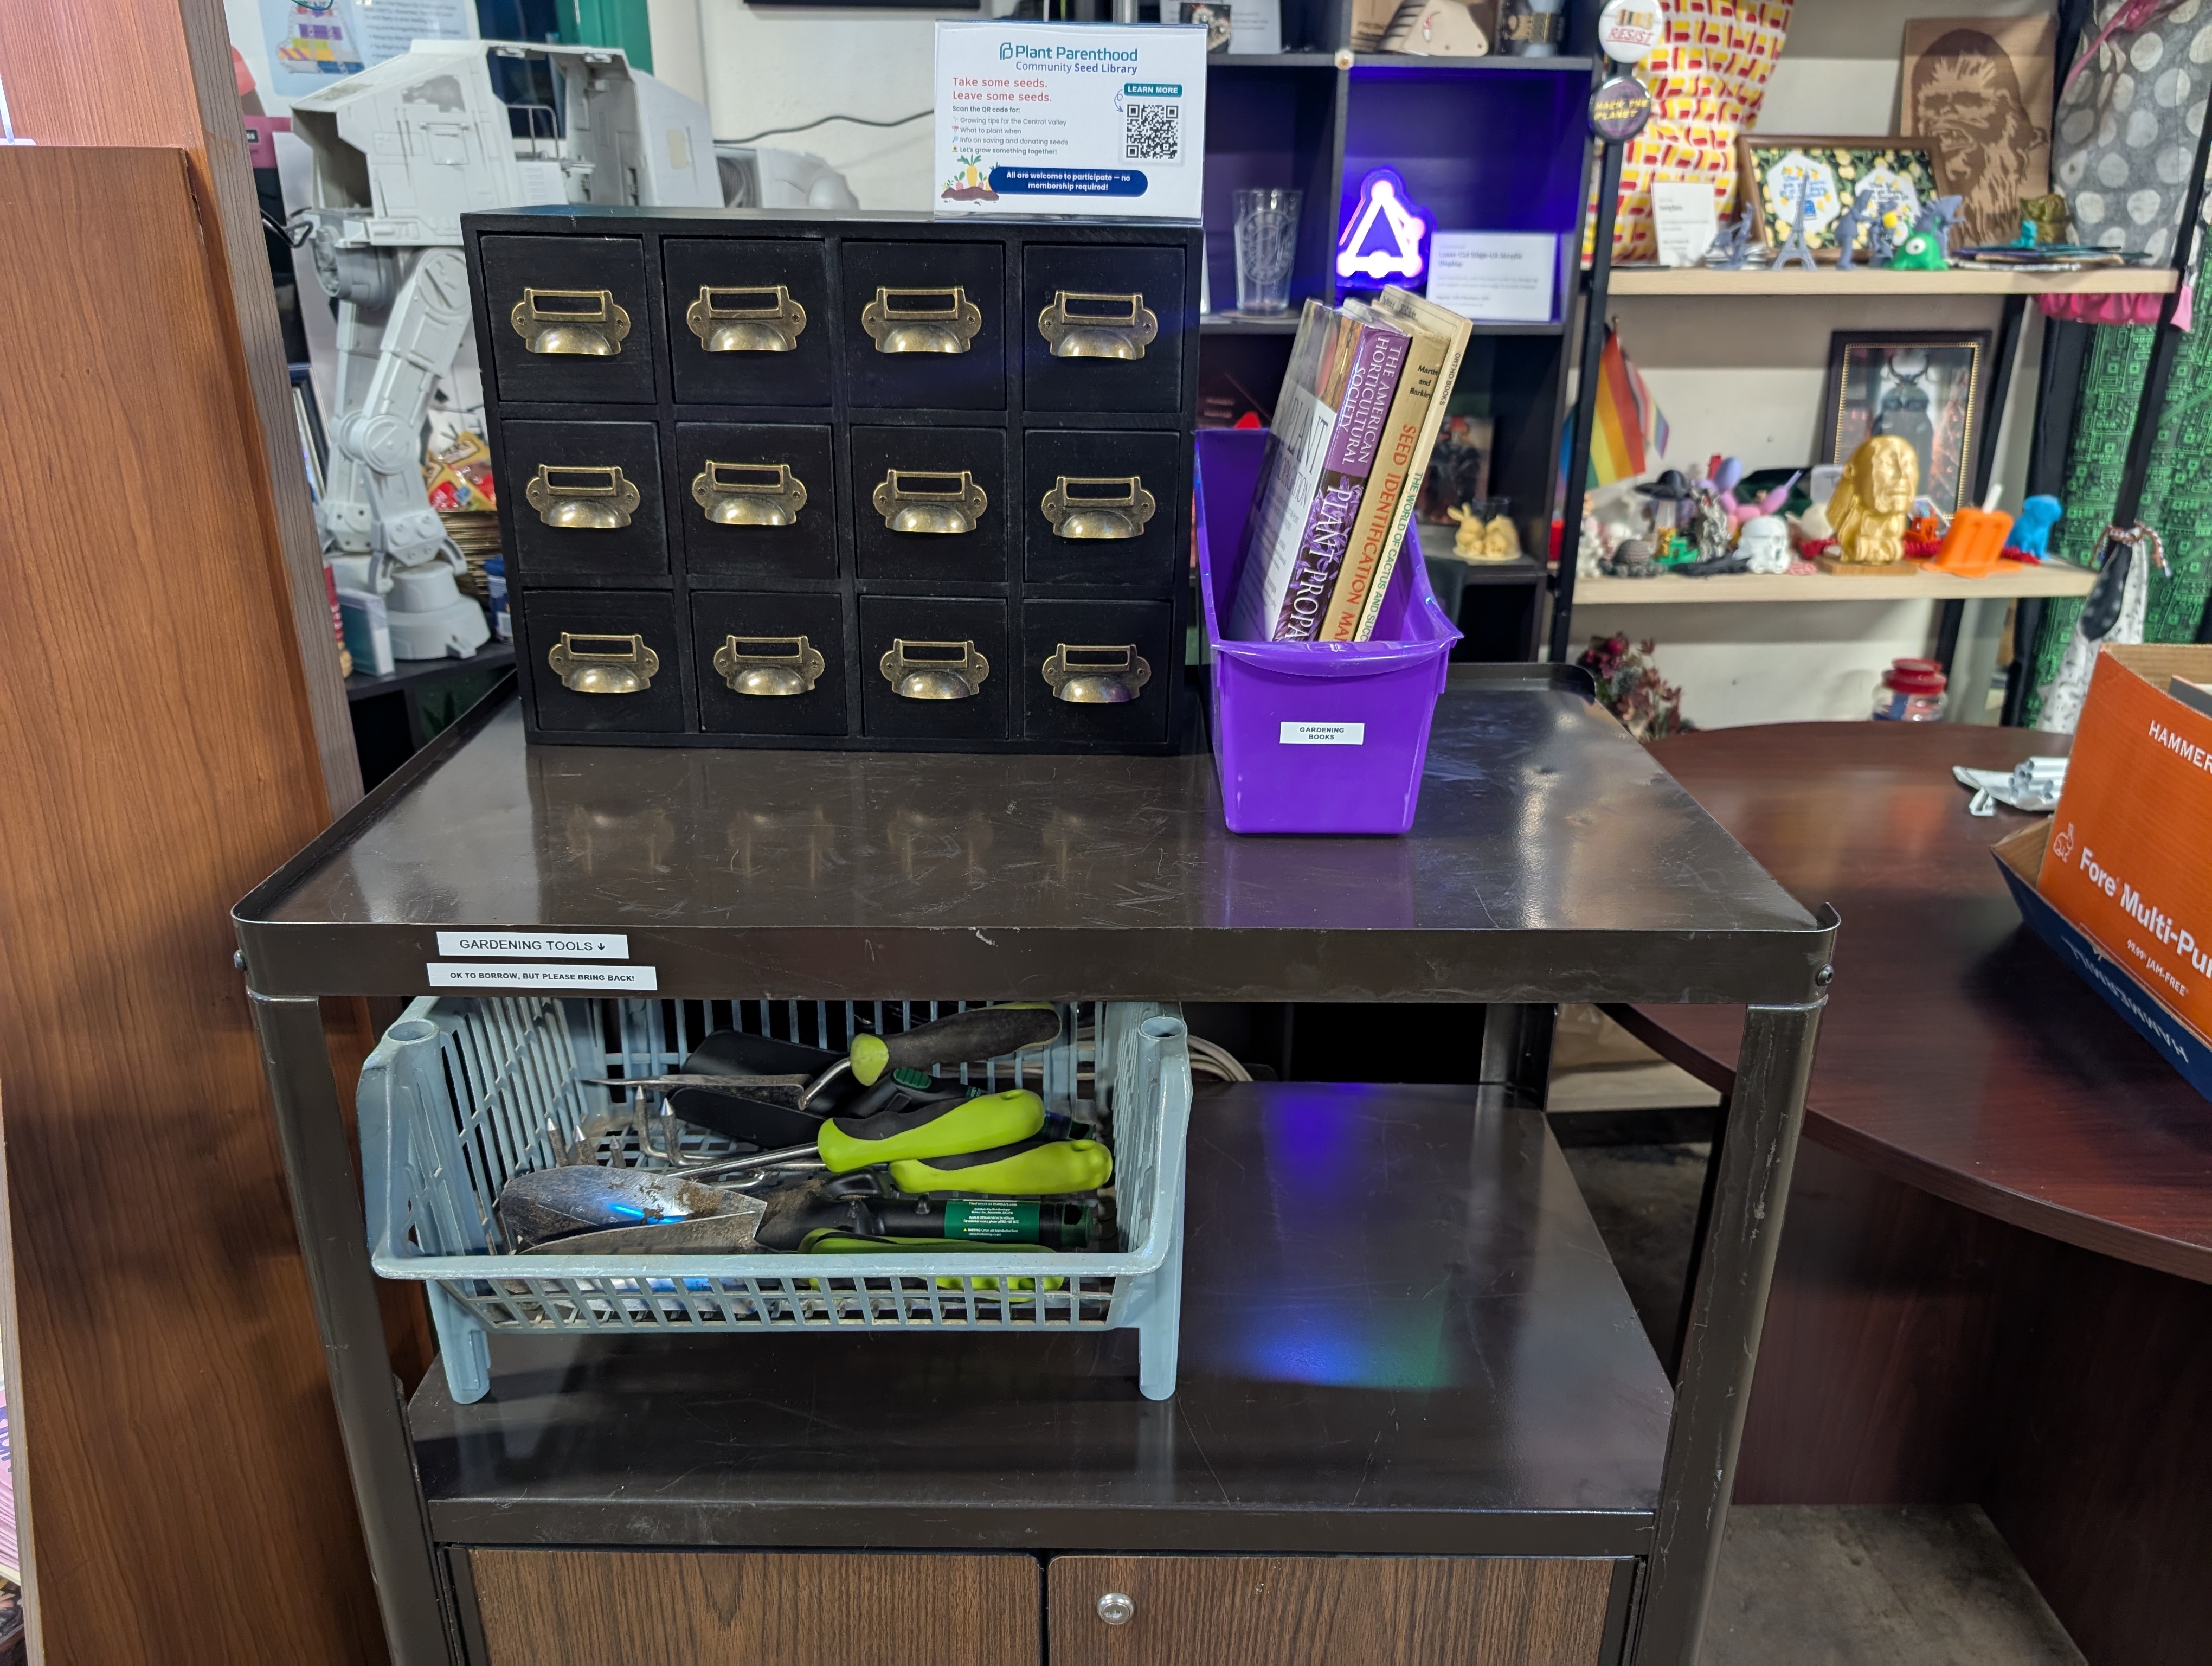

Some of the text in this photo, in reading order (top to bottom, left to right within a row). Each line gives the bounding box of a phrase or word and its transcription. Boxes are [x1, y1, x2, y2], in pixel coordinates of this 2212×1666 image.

[1015, 44, 1138, 61] Plant Parenthood
[1015, 61, 1137, 75] Community Seed Library
[953, 77, 978, 86] Take
[1014, 78, 1048, 88] seeds.
[953, 91, 1052, 101] Leave some seeds.
[1594, 109, 1639, 121] PLANET
[1019, 138, 1049, 146] donating
[1028, 183, 1109, 192] membership required!
[1383, 347, 1402, 377] THE
[1418, 365, 1439, 376] Martin
[1439, 353, 1461, 406] ORTHO BOOKS
[1339, 367, 1366, 432] SOCIETY
[1342, 337, 1390, 465] HORTICULTURAL
[1410, 387, 1432, 400] Barkley
[1358, 381, 1390, 464] AMERICAN
[1280, 398, 1328, 475] PLANT
[1393, 424, 1417, 466] SEED
[1410, 472, 1423, 492] THE
[1396, 493, 1416, 531] WORLD
[1346, 473, 1401, 606] IDENTIFICATION
[1392, 531, 1403, 546] OF
[1285, 486, 1353, 639] PLANT PROPA
[1379, 547, 1397, 587] CACTUS
[1369, 588, 1384, 613] AND
[459, 939, 594, 951] GARDENING TOOLS
[479, 972, 521, 981] BORROW,
[2061, 935, 2189, 1064] HAMMERMILL
